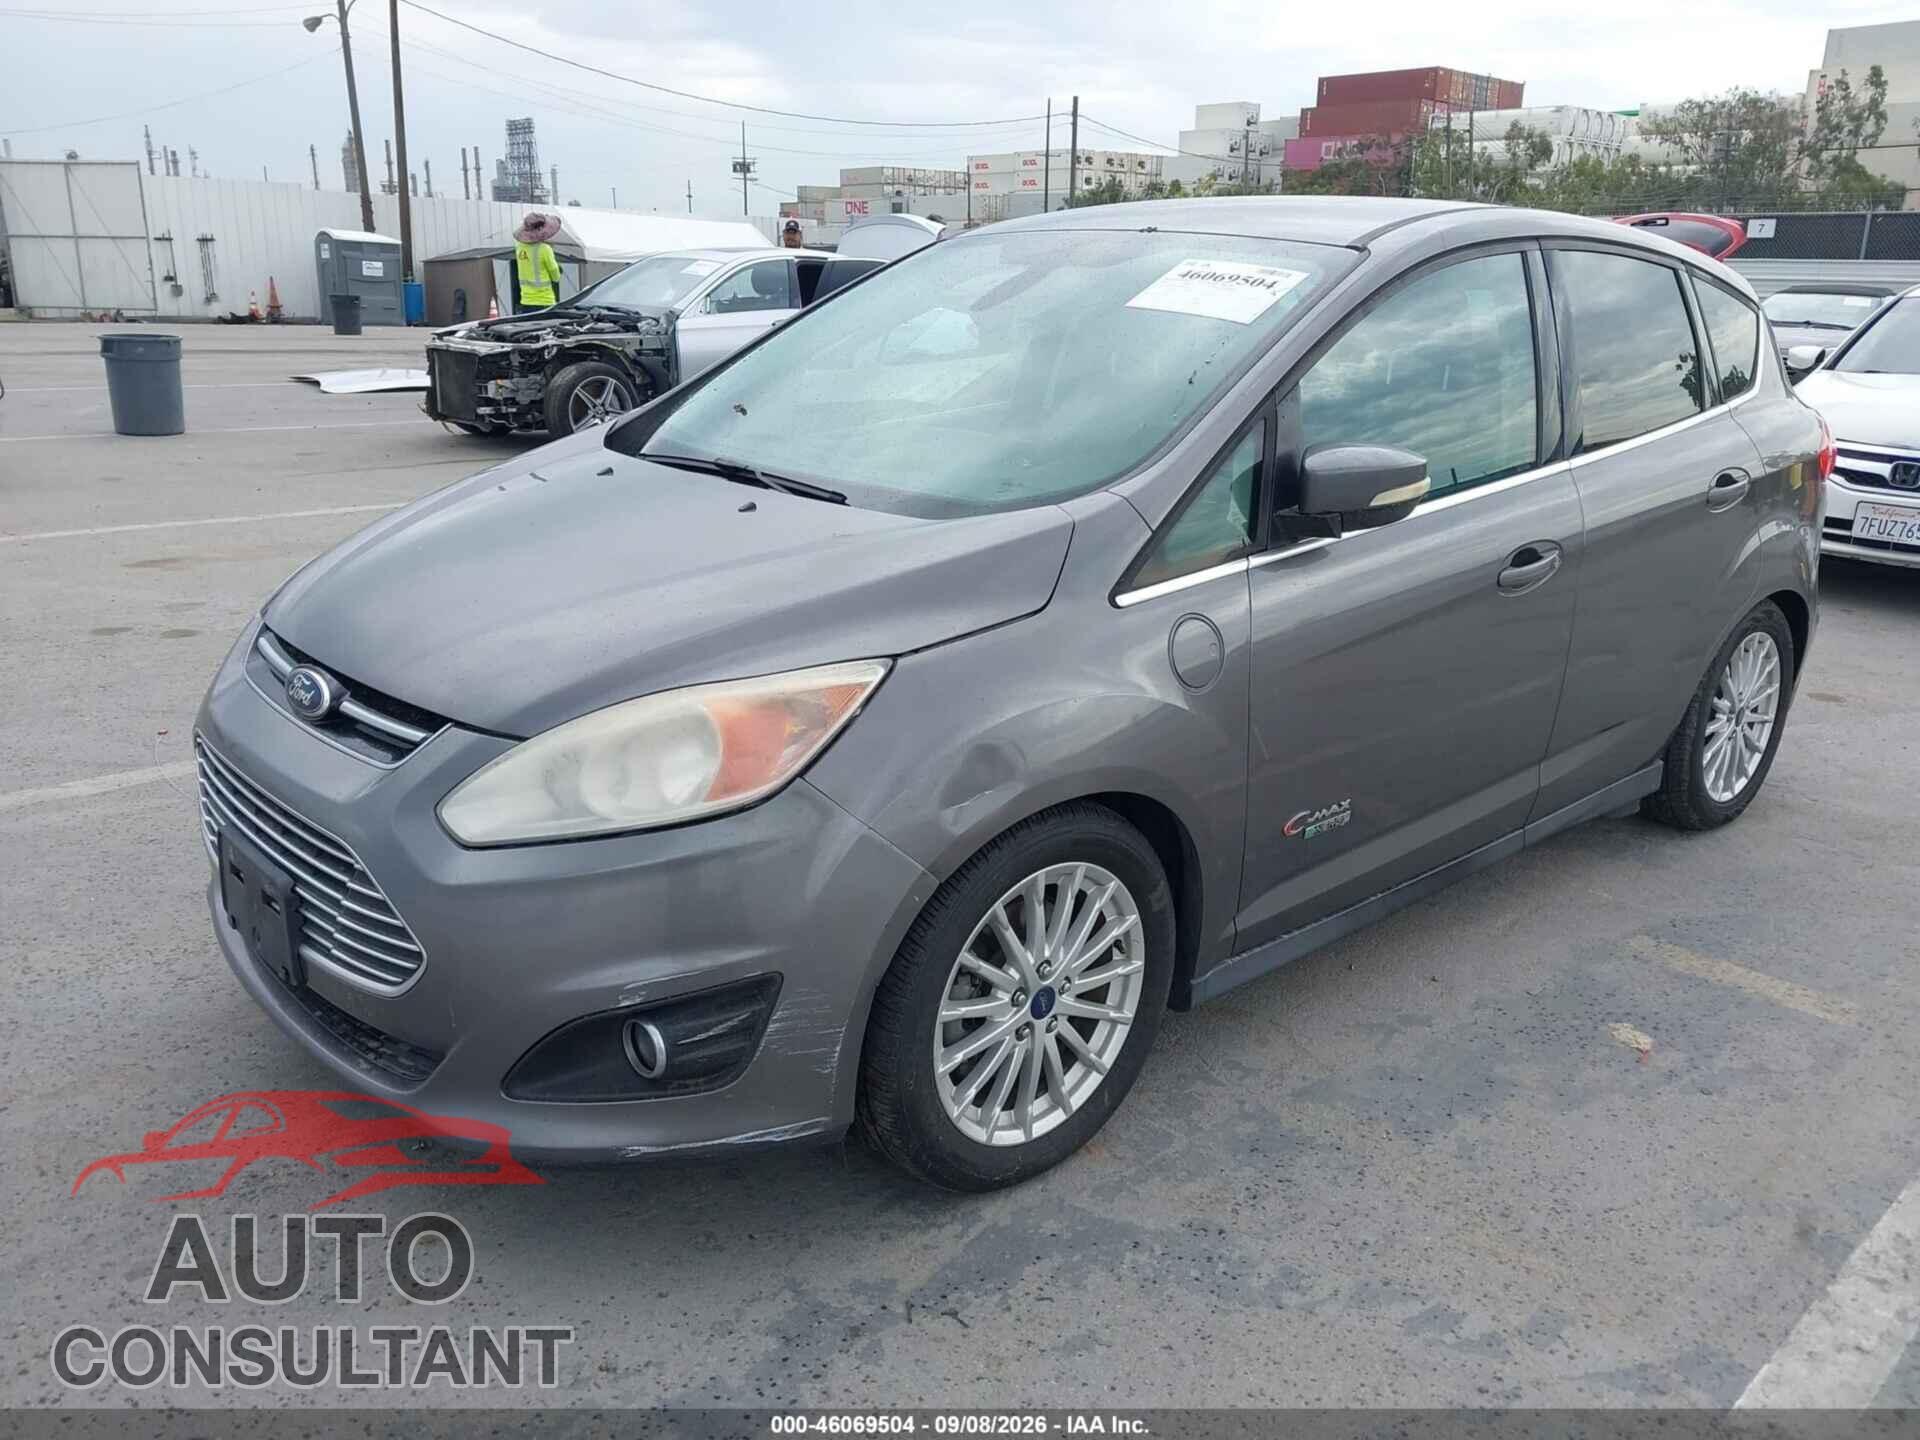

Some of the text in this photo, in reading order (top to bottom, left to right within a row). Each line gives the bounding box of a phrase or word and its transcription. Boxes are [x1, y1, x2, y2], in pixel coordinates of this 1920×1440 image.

[844, 200, 869, 215] ONE
[1758, 223, 1766, 233] 7
[1177, 269, 1280, 291] 46069504
[288, 674, 315, 706] Ford
